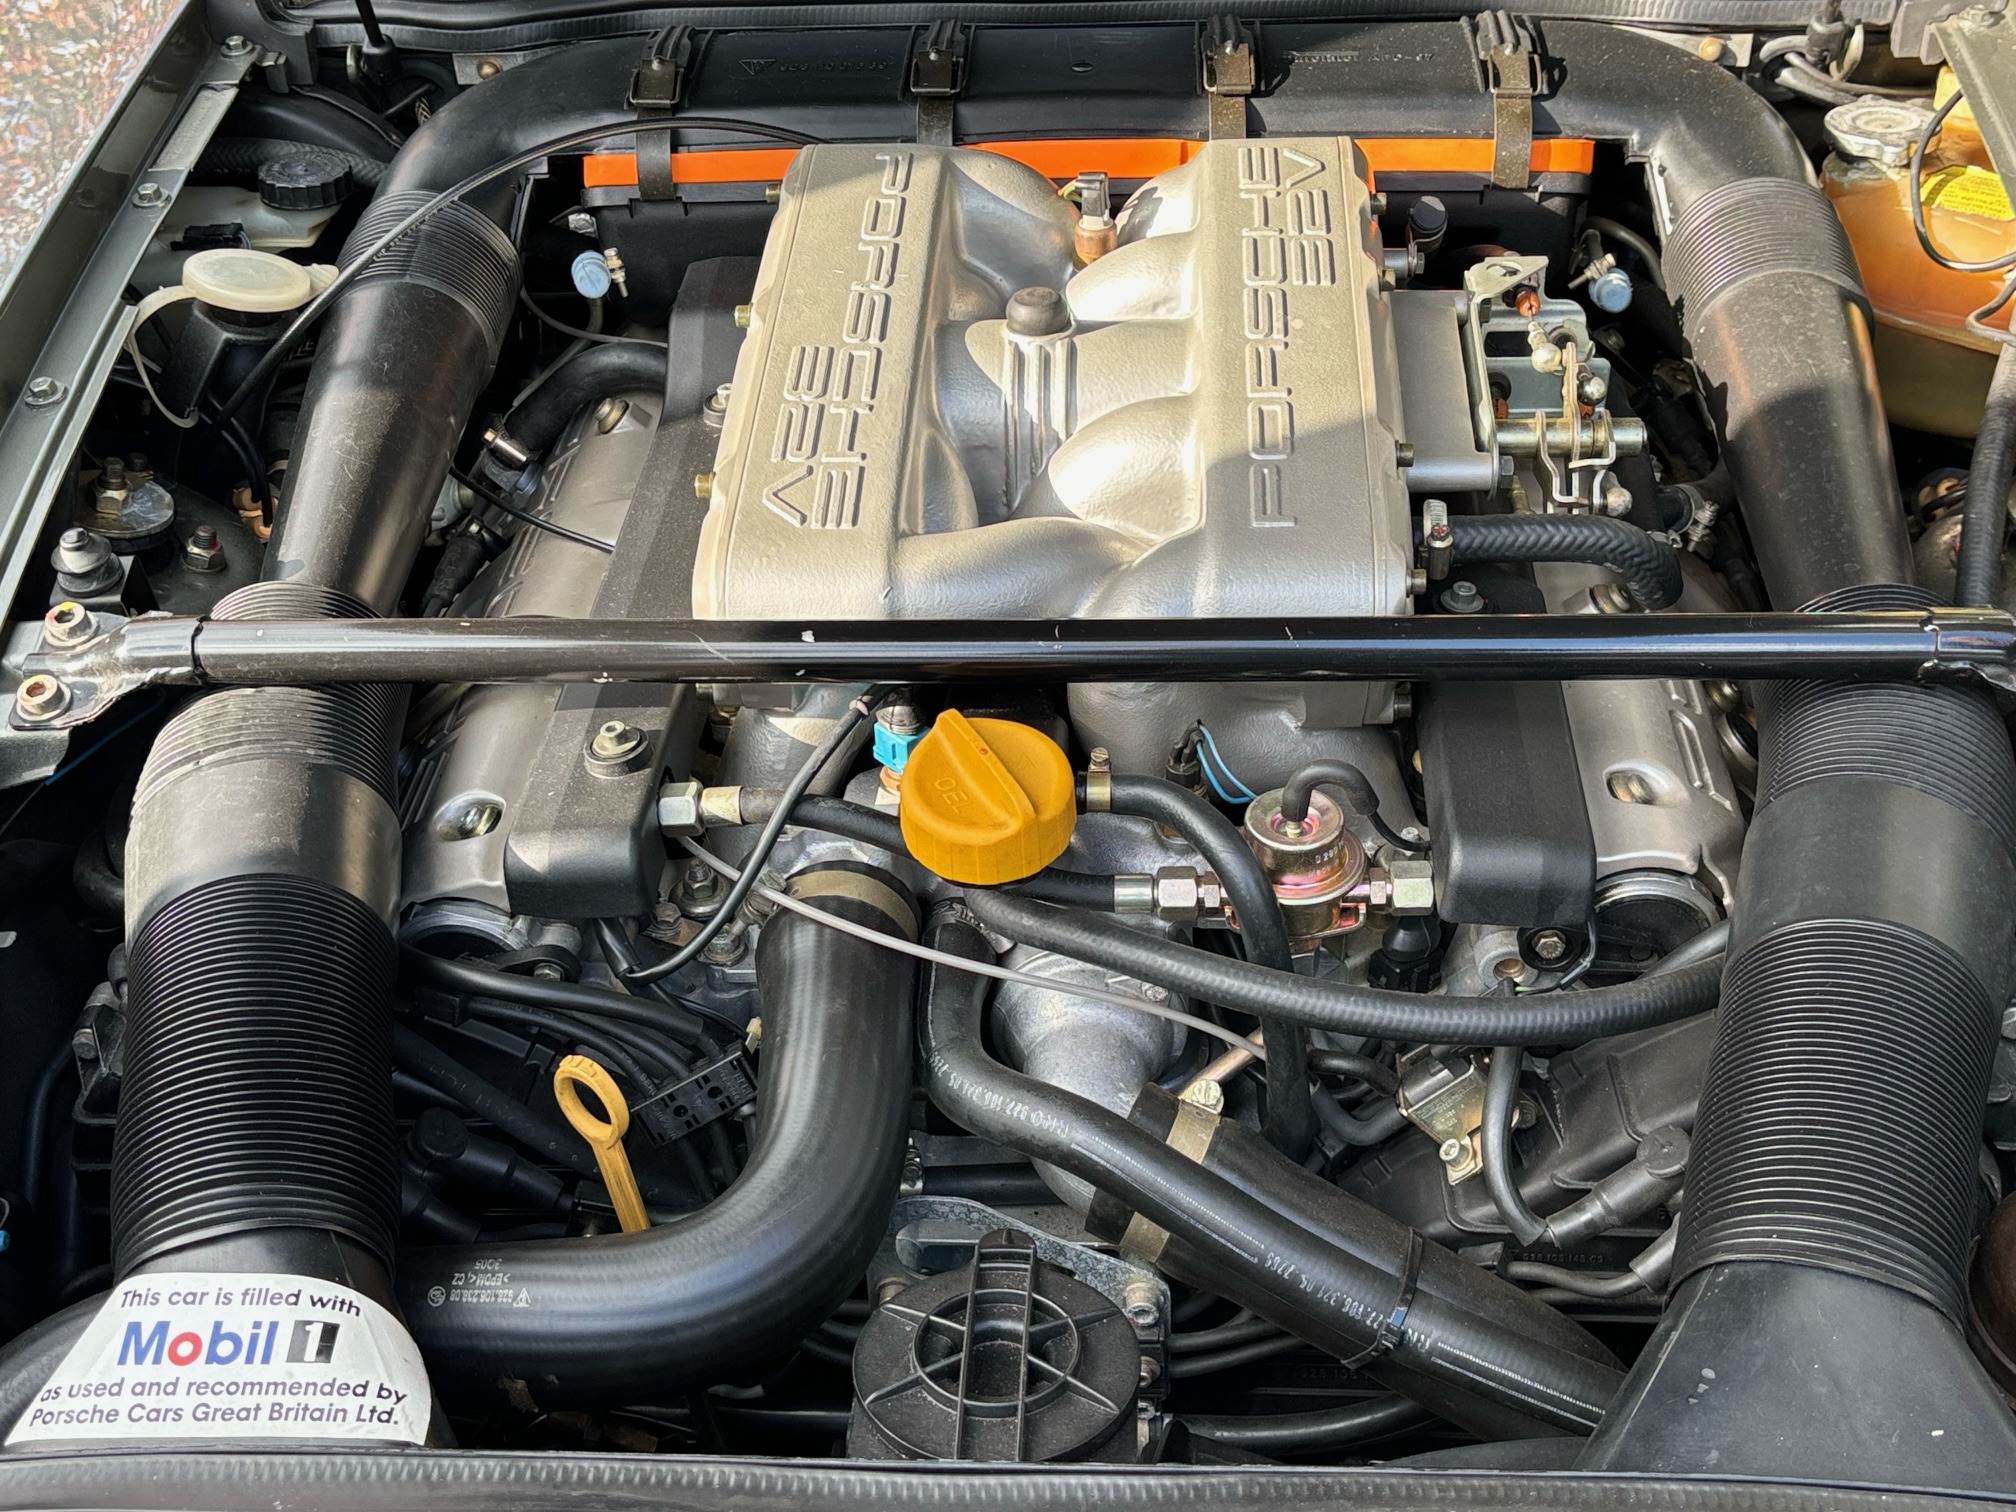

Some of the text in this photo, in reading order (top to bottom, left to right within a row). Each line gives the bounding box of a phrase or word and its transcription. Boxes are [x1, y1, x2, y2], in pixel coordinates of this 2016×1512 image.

[1282, 146, 1336, 287] 32V
[809, 152, 914, 530] PORSCHE
[1238, 146, 1298, 529] PORSCHE
[762, 345, 834, 528] 32V
[934, 776, 974, 814] OEL
[121, 1288, 361, 1317] This car is filled with
[117, 1321, 279, 1366] Mobil
[40, 1377, 408, 1406] as used and recommended by
[29, 1402, 400, 1427] Porsche Cars Great Britain Ltd.
